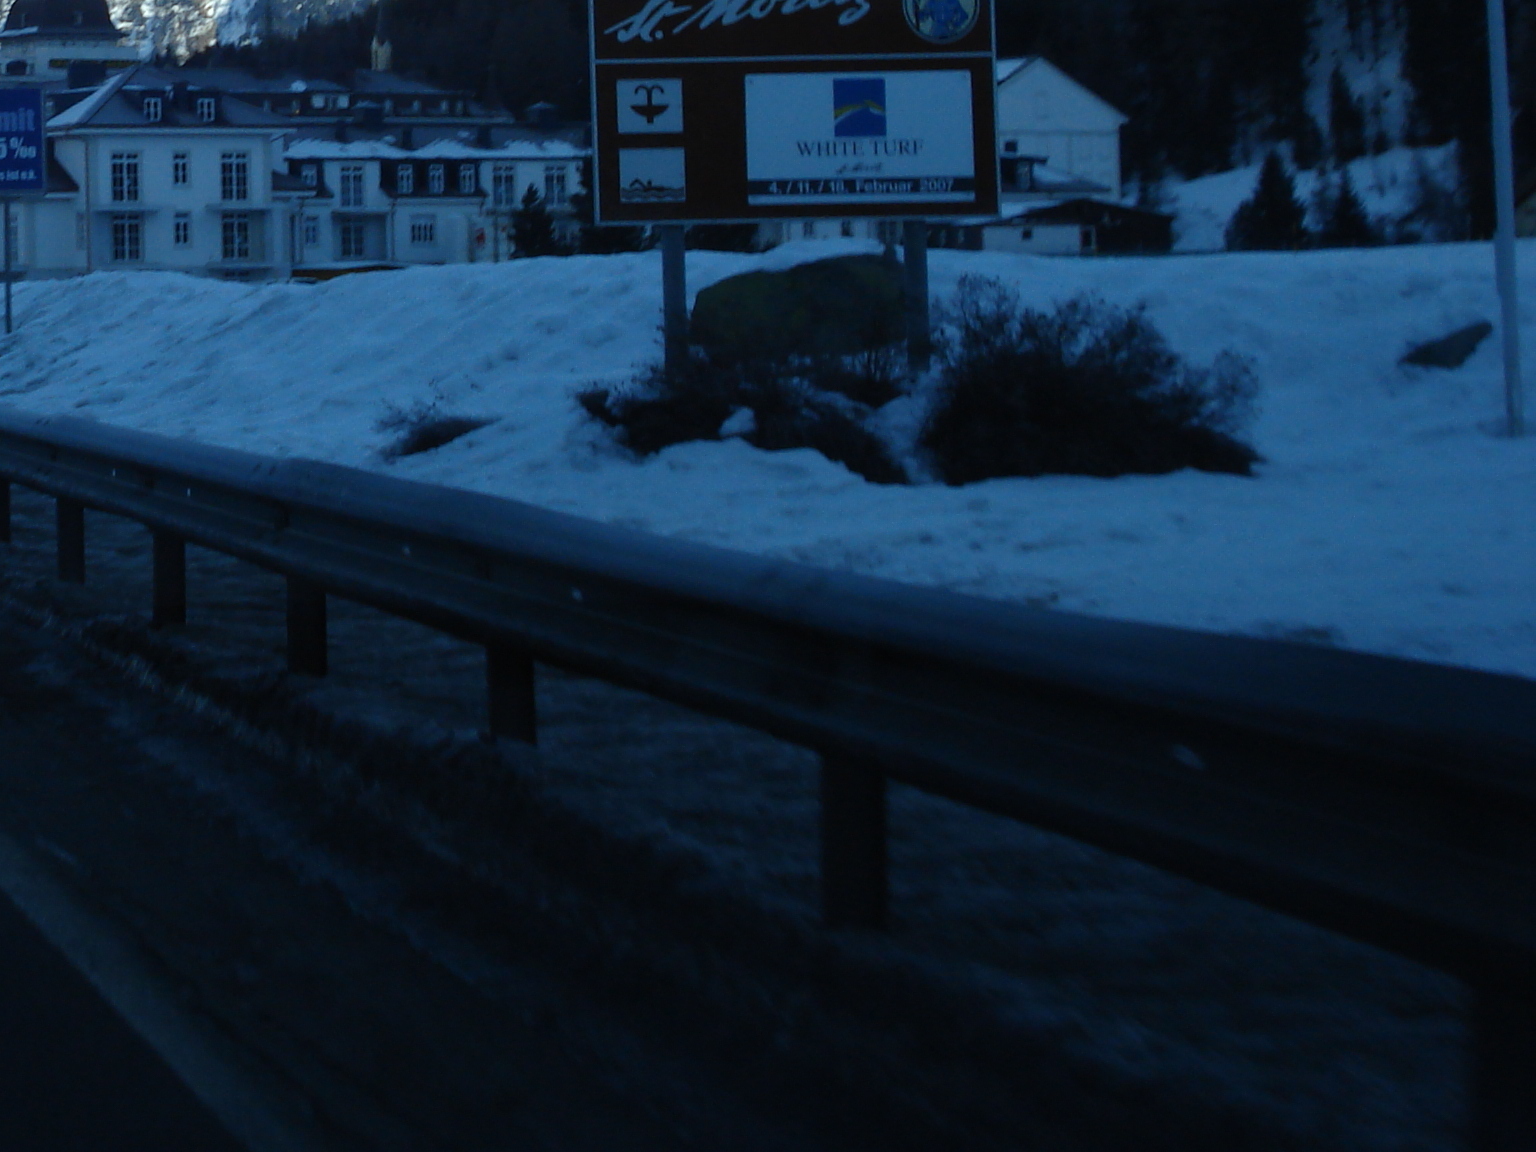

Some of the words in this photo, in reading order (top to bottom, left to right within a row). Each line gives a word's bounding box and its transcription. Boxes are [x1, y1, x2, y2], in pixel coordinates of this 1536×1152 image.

[796, 140, 865, 157] WHITE
[869, 138, 924, 156] TURF
[855, 178, 912, 193] Februar
[920, 177, 954, 192] 2007
